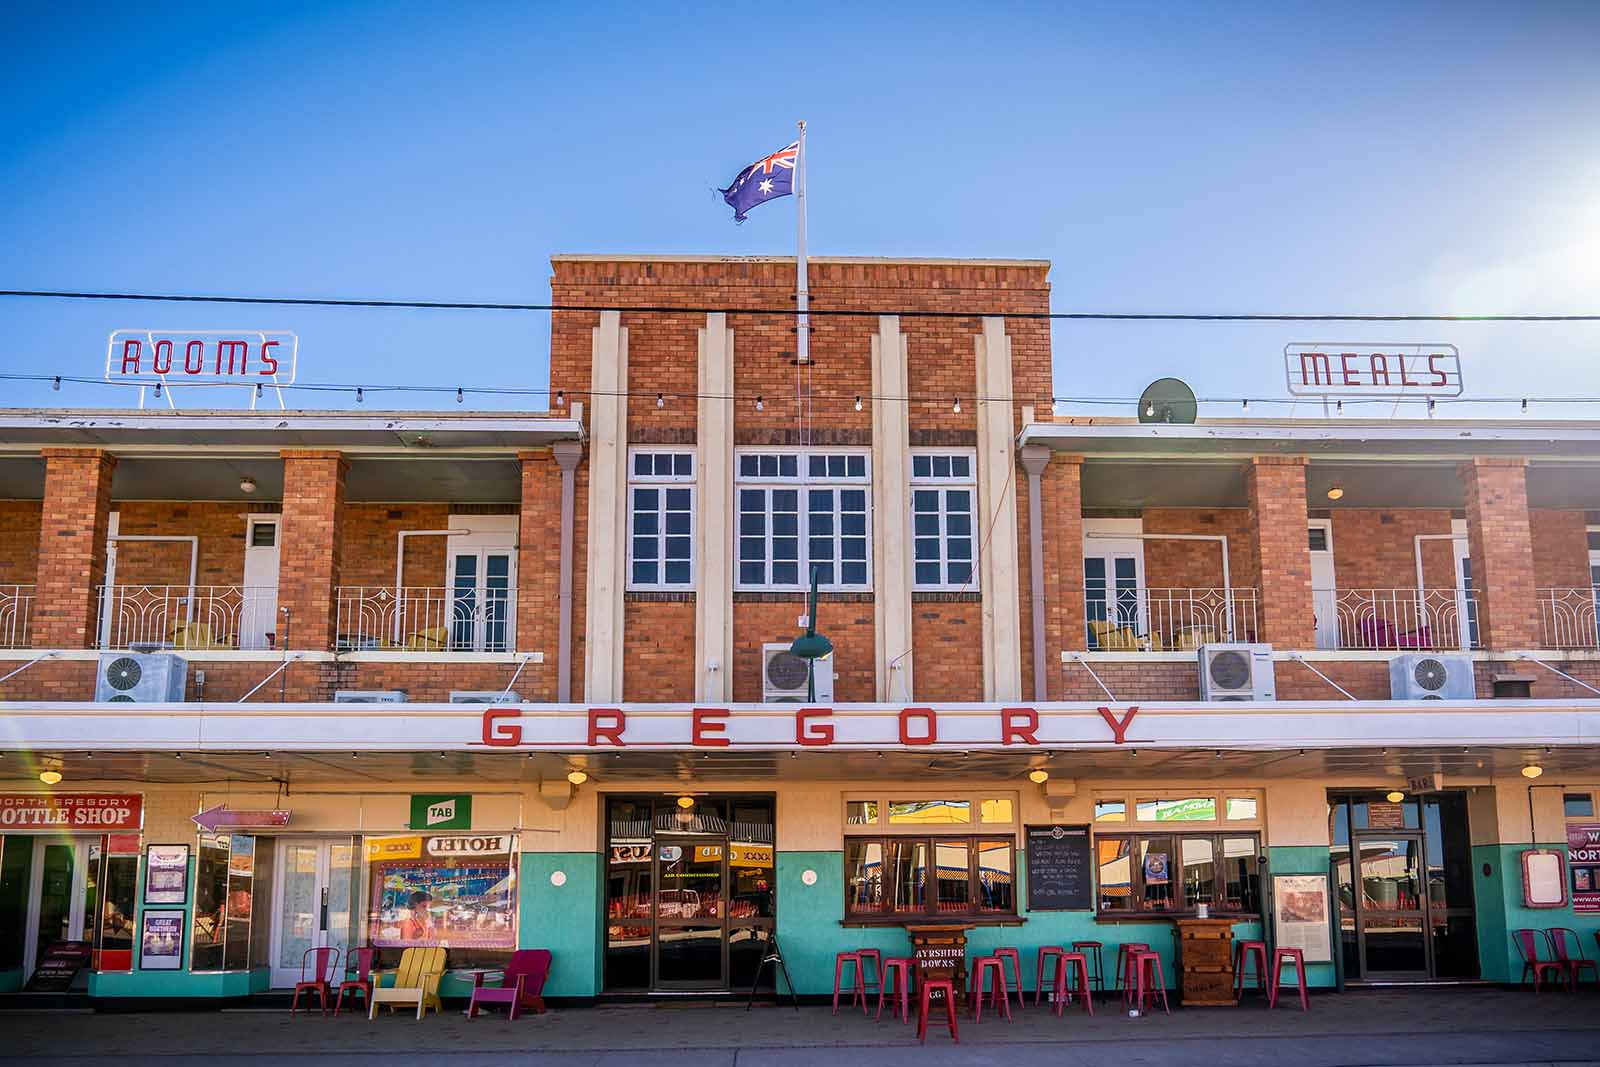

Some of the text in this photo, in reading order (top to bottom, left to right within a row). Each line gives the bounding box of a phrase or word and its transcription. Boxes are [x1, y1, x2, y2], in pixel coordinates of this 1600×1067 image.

[121, 340, 279, 375] ROOMS
[1300, 353, 1447, 386] MEALS
[482, 707, 1139, 747] GREGORY
[0, 808, 130, 824] OTTLE SHOP
[430, 807, 453, 818] TAB
[916, 949, 964, 958] AYRSHIRE
[921, 959, 954, 968] DOWNS
